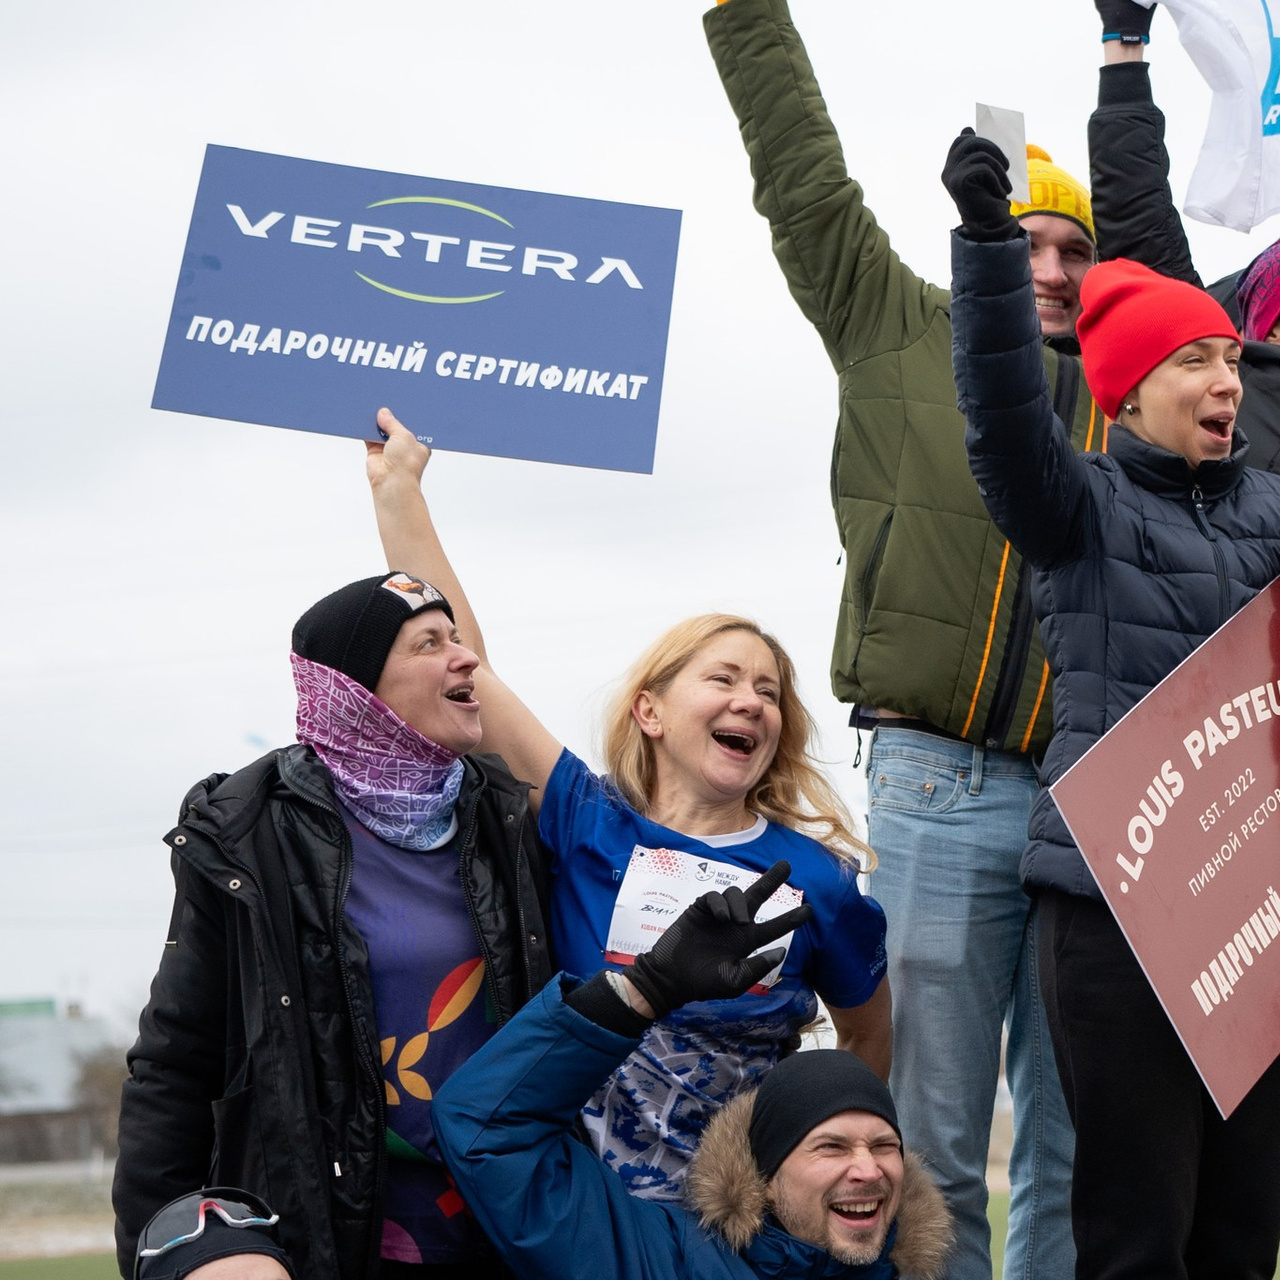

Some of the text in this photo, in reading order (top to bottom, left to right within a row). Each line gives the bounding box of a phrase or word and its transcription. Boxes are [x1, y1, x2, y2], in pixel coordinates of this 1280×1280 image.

[226, 204, 644, 289] VERTERA
[185, 315, 649, 401] ПОДАРОЧНЫЙ СЕРТИФИКАТ
[1115, 759, 1186, 883] LOUIS
[1198, 767, 1257, 834] EST. 2022
[1188, 834, 1242, 897] ПИВНОЙ
